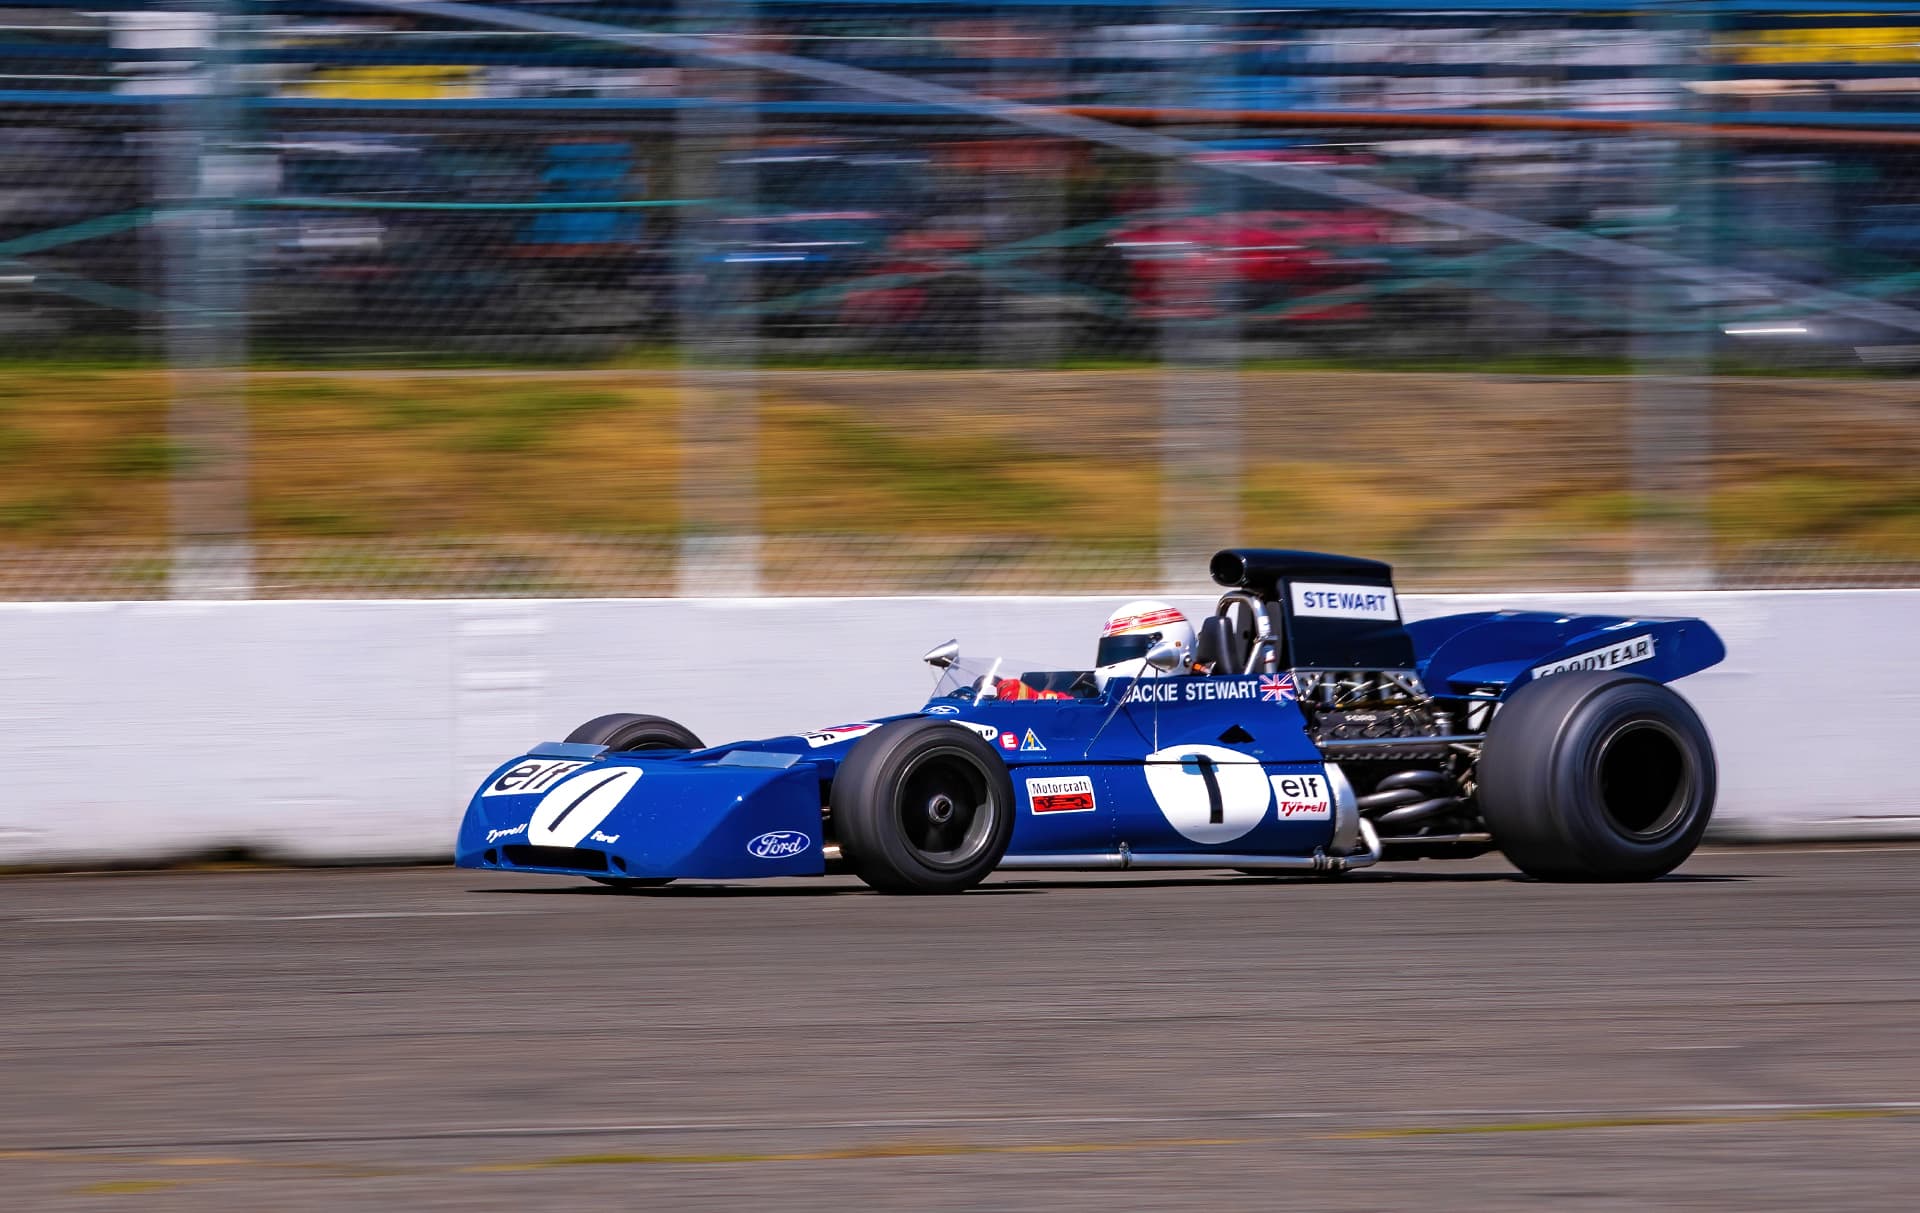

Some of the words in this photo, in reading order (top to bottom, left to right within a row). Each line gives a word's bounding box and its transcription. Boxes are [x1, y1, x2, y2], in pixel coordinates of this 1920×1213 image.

[1304, 591, 1386, 611] STEWART
[1186, 681, 1258, 700] STEWART
[1001, 734, 1017, 748] E
[495, 762, 582, 791] elf
[1032, 781, 1089, 794] Motorcraft
[1198, 754, 1224, 824] 1
[1281, 777, 1318, 797] elf
[547, 771, 628, 832] 1
[1281, 801, 1327, 816] Tyrrell
[757, 834, 801, 856] Ford
